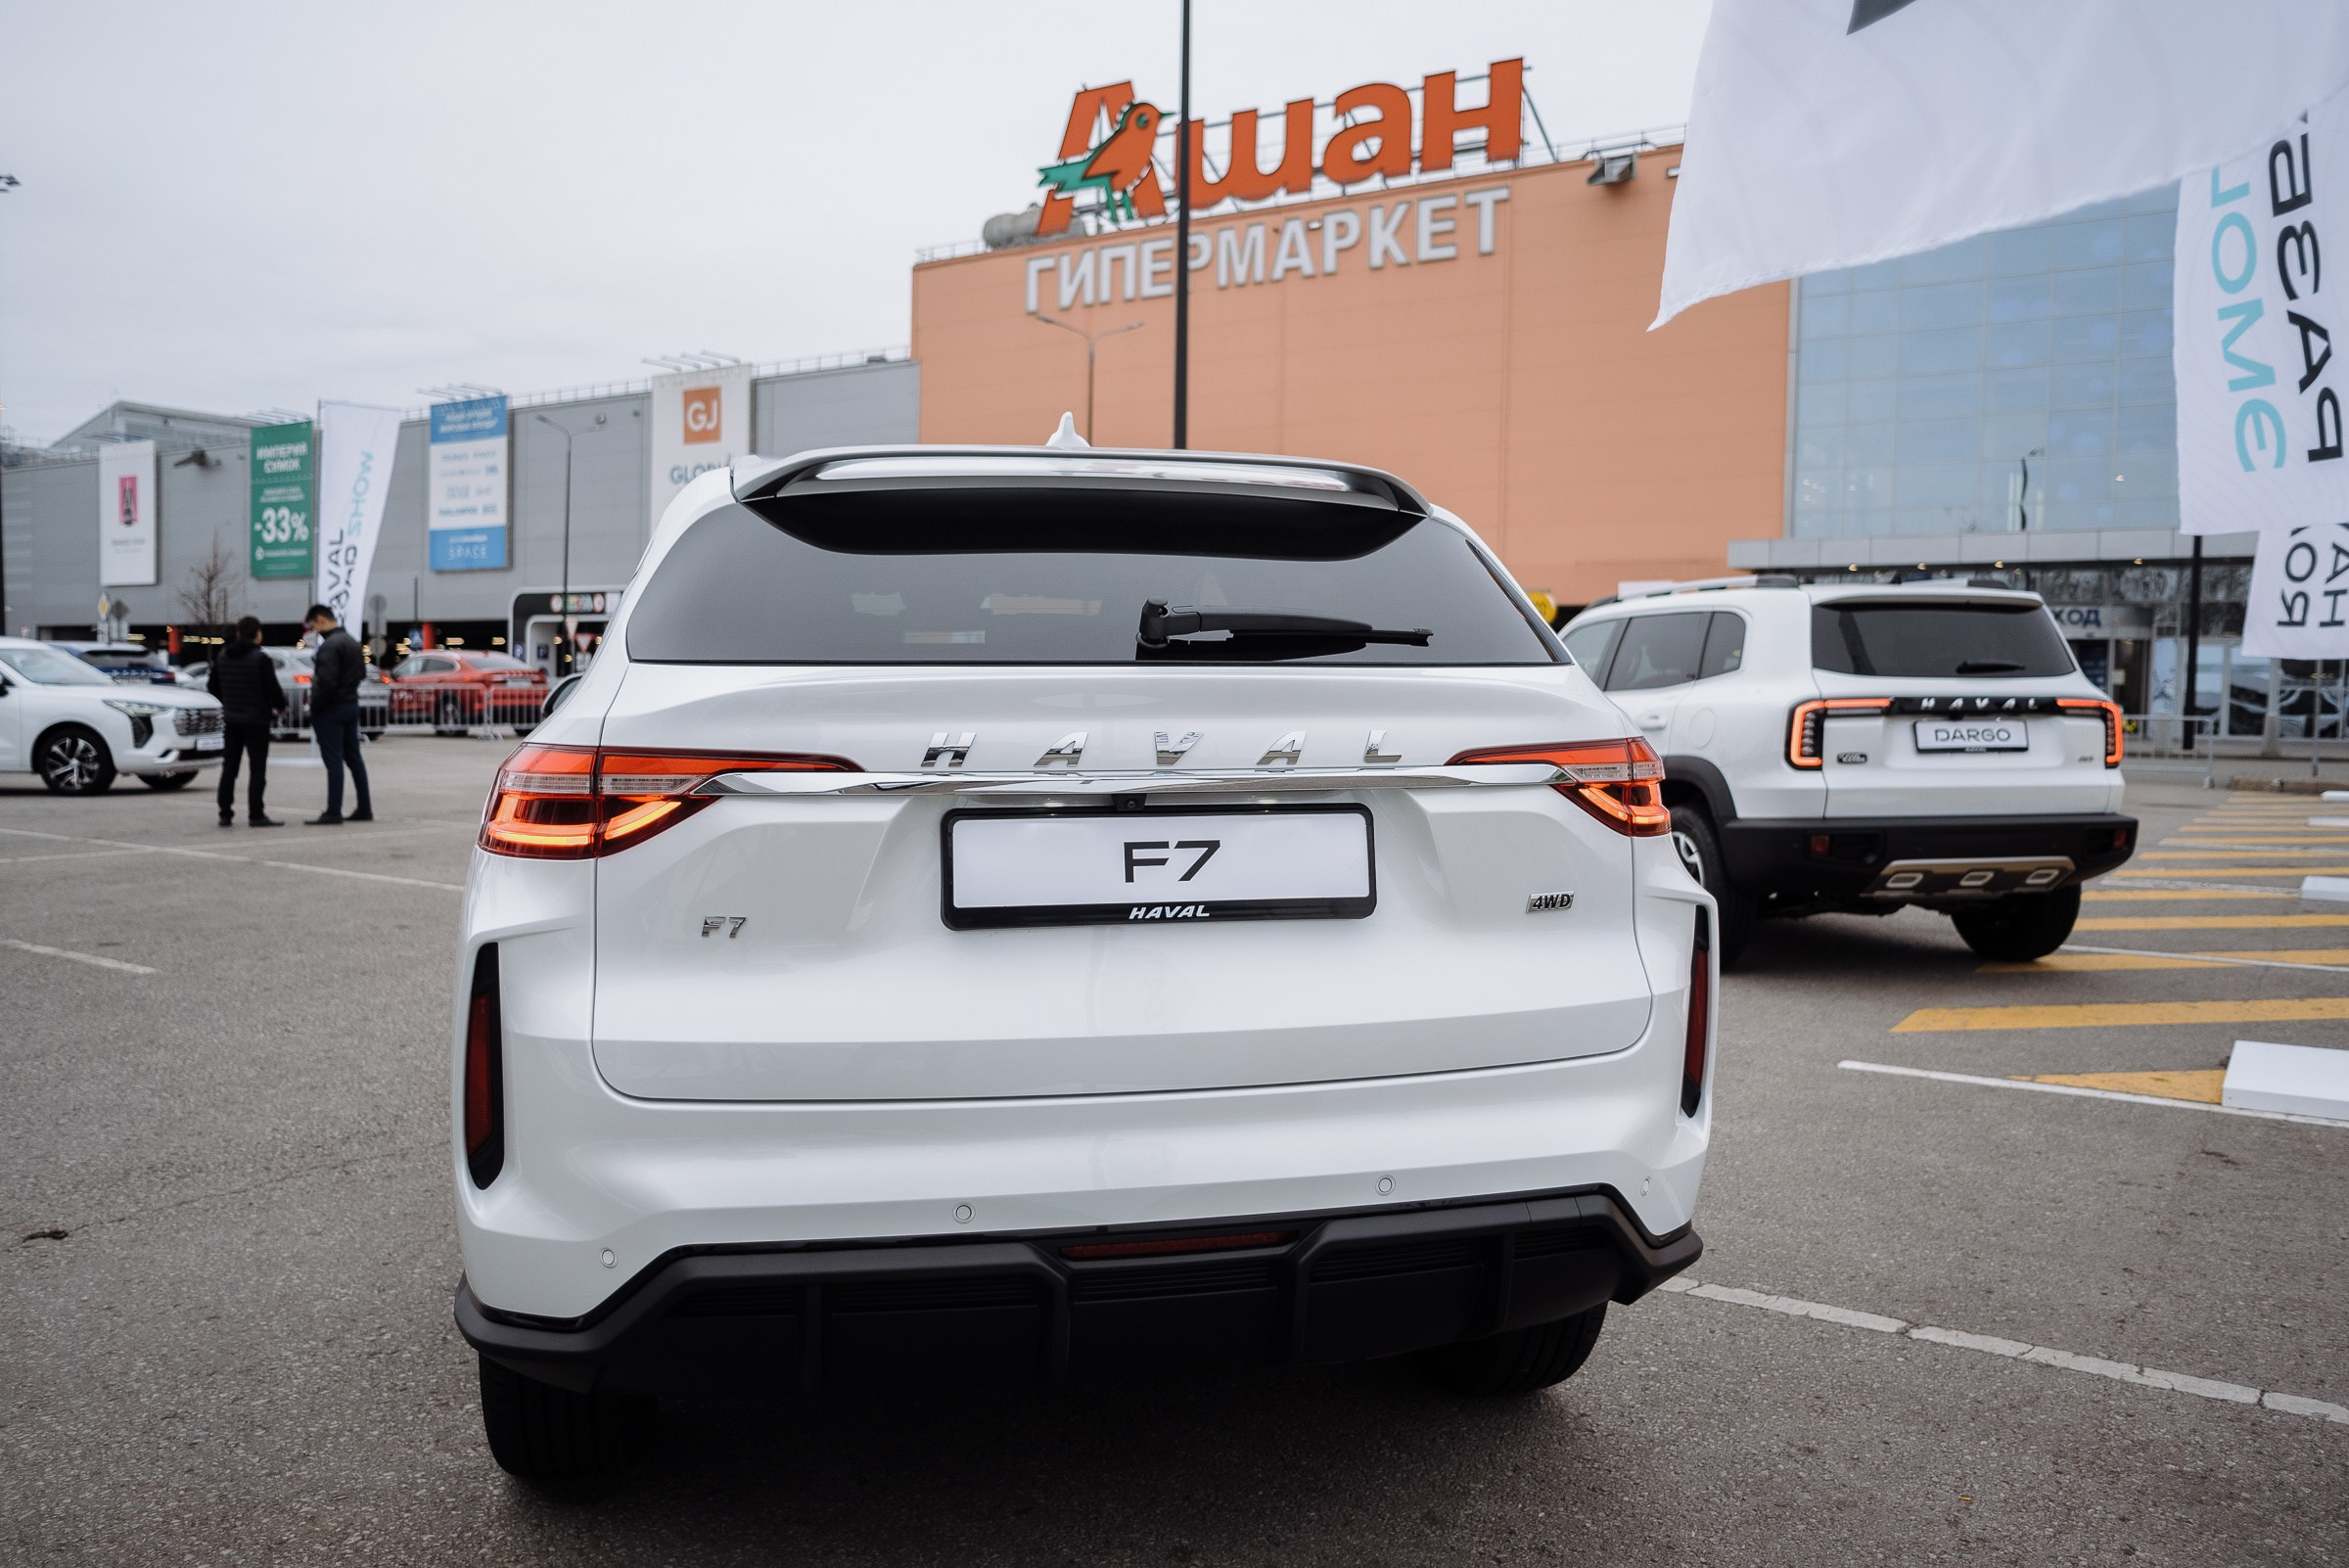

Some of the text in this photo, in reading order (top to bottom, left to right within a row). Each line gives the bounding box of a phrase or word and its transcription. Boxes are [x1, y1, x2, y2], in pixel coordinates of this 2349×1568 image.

[1036, 58, 1523, 236] Ашан
[1025, 186, 1510, 314] ГИПЕРМАРКЕТ
[688, 399, 718, 432] GJ
[346, 449, 374, 537] SHOW
[254, 506, 309, 543] -33%
[328, 528, 345, 610] AVAL
[2052, 609, 2101, 627] ХОД
[1920, 697, 2037, 710] HAVAL
[920, 730, 1403, 767] HAVAL
[1934, 728, 2010, 742] DARGO
[1124, 840, 1221, 883] F7
[1128, 904, 1210, 919] HAVAL
[1532, 894, 1571, 909] 4WD
[702, 915, 748, 939] F7
